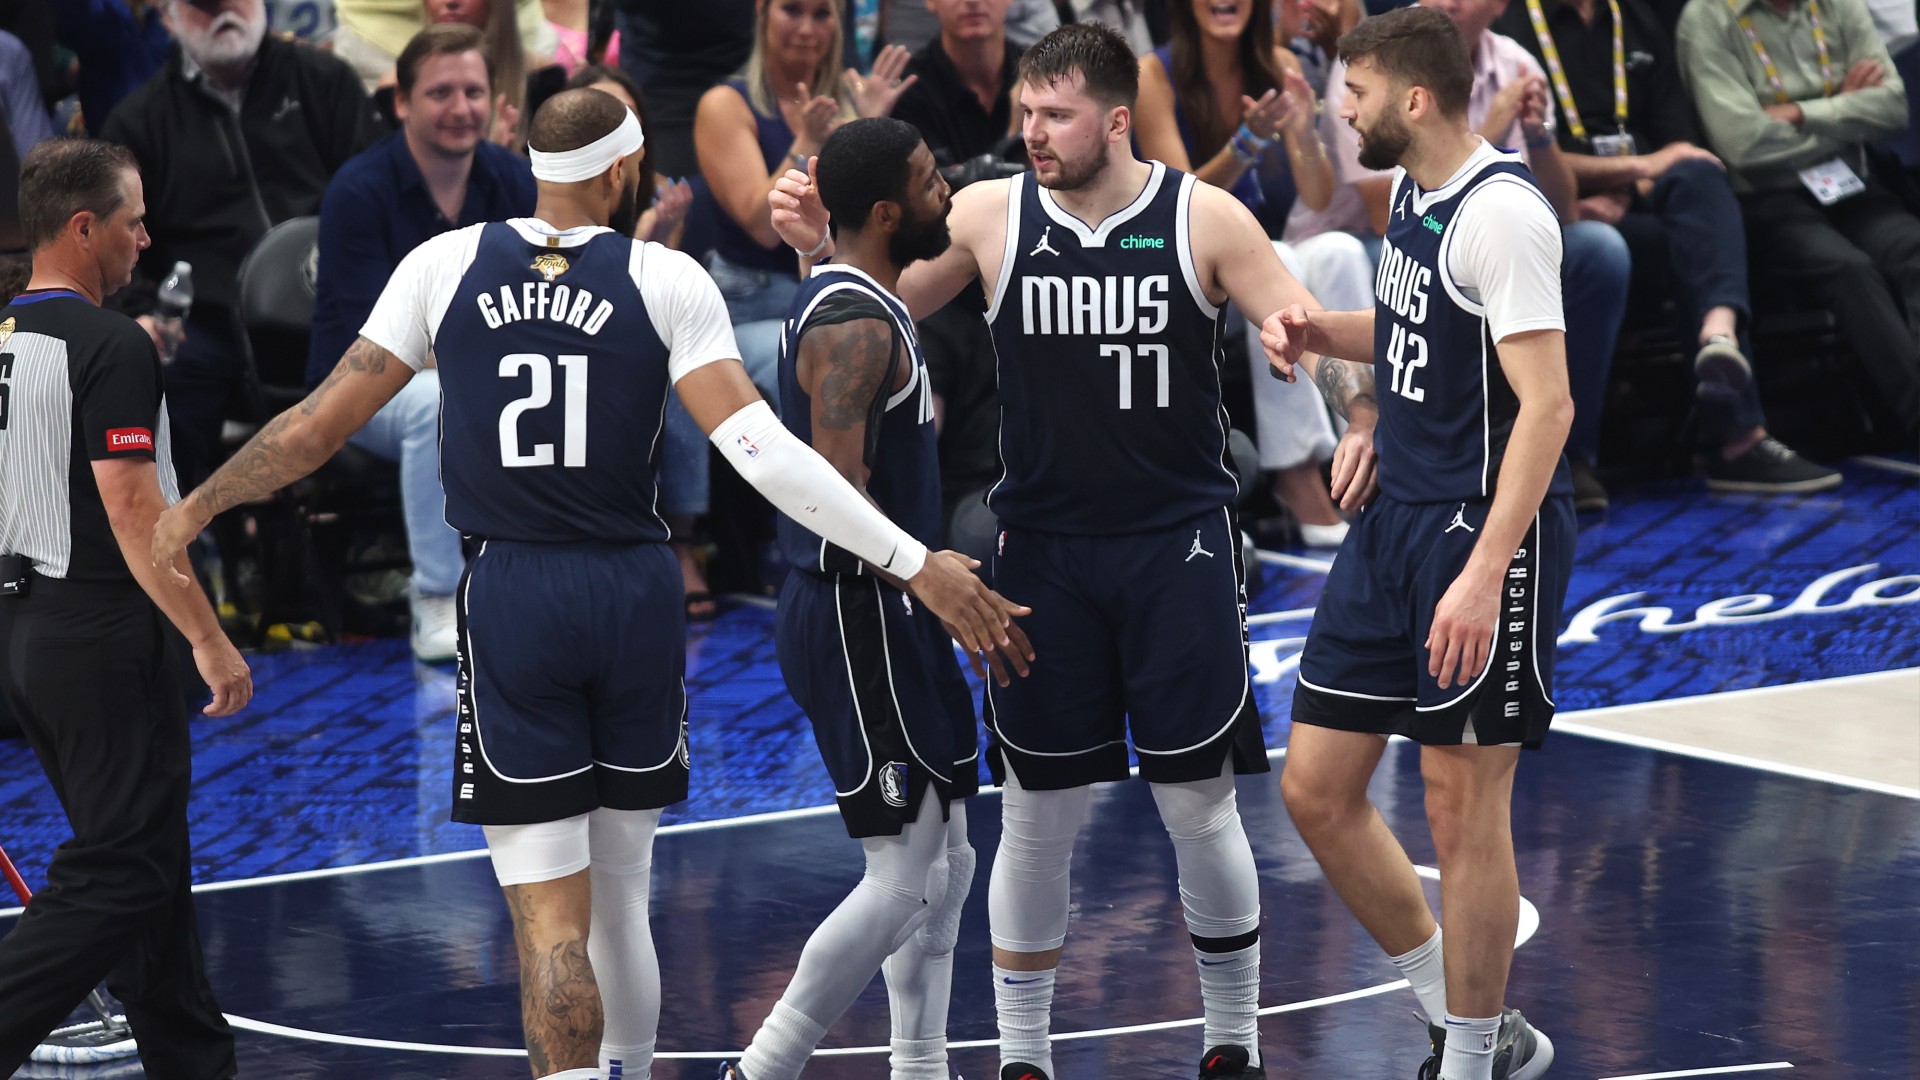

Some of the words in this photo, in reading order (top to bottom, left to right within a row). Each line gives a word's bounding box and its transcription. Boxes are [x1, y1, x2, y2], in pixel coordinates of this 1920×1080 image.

[1120, 234, 1165, 249] chime
[1422, 213, 1445, 235] chime
[530, 255, 570, 269] Finals
[476, 281, 614, 336] GAFFORD
[1021, 274, 1169, 335] MAVS
[1099, 343, 1170, 410] 77
[1386, 321, 1429, 403] 42
[498, 353, 589, 468] 21
